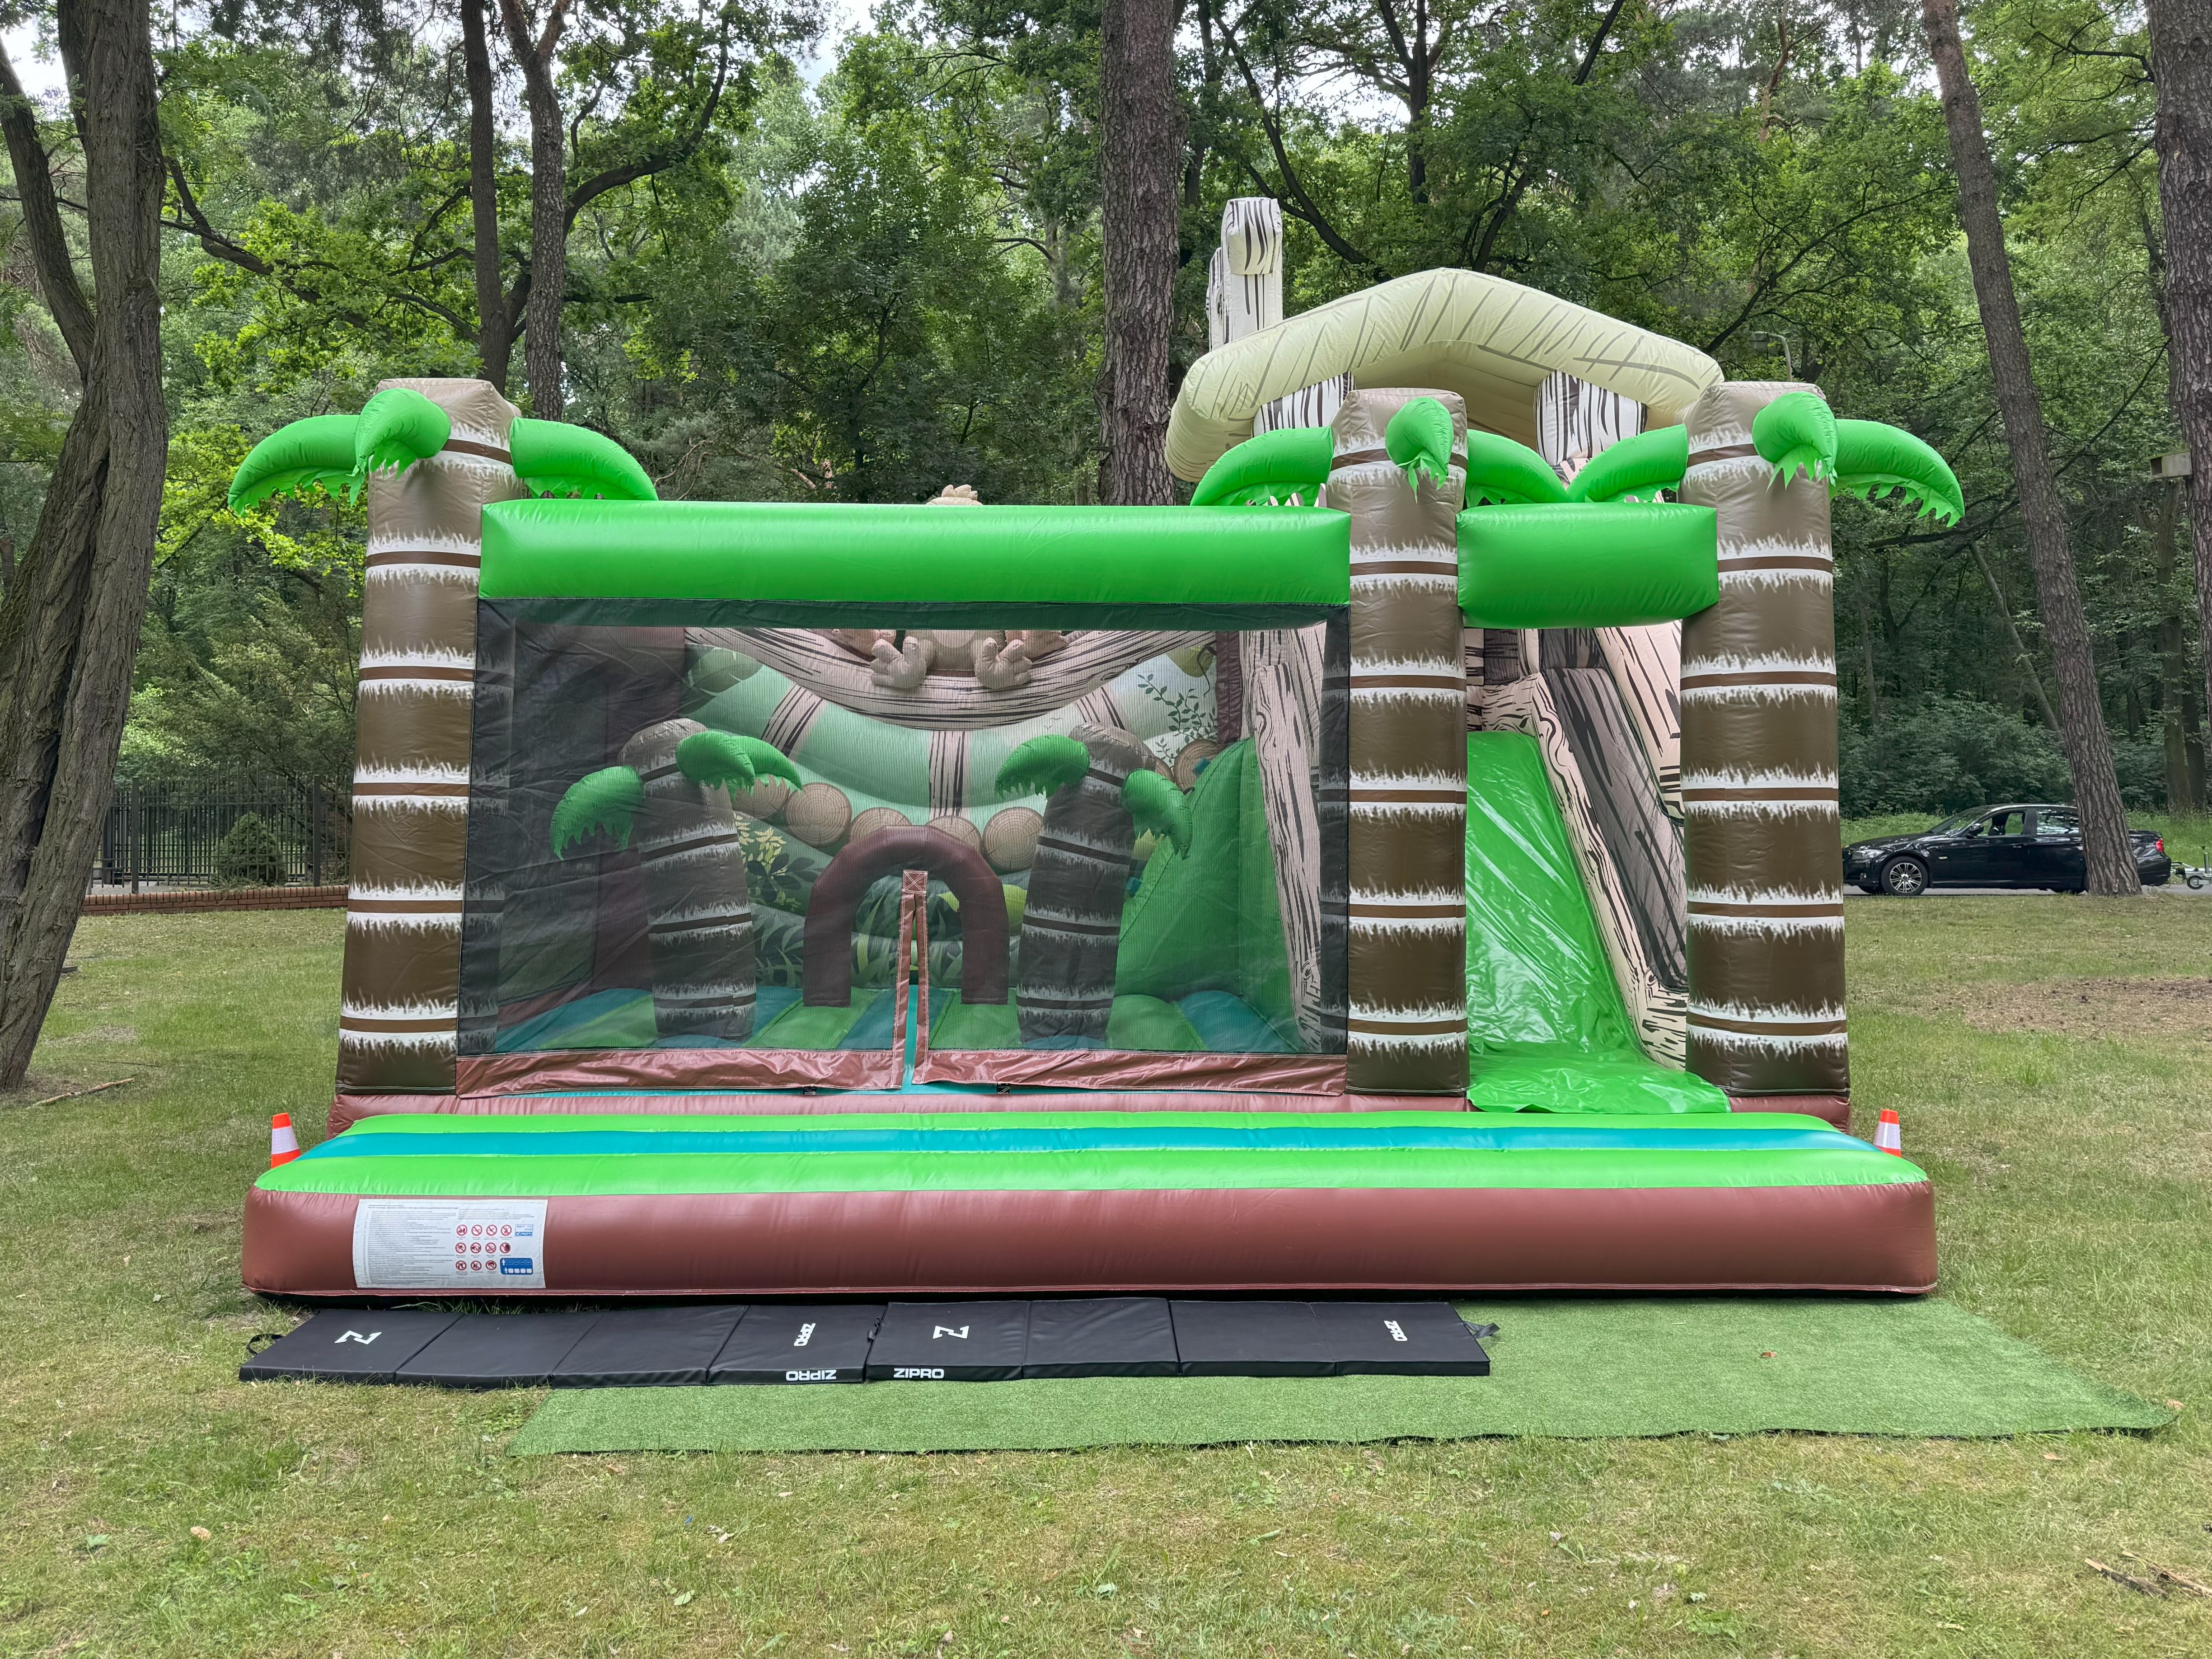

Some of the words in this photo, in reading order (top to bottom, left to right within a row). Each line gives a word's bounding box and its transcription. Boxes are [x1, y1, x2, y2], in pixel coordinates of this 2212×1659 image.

[794, 1323, 816, 1346] ZIPRO
[786, 1369, 837, 1381] ZIPRO
[894, 1368, 944, 1379] ZIPRO
